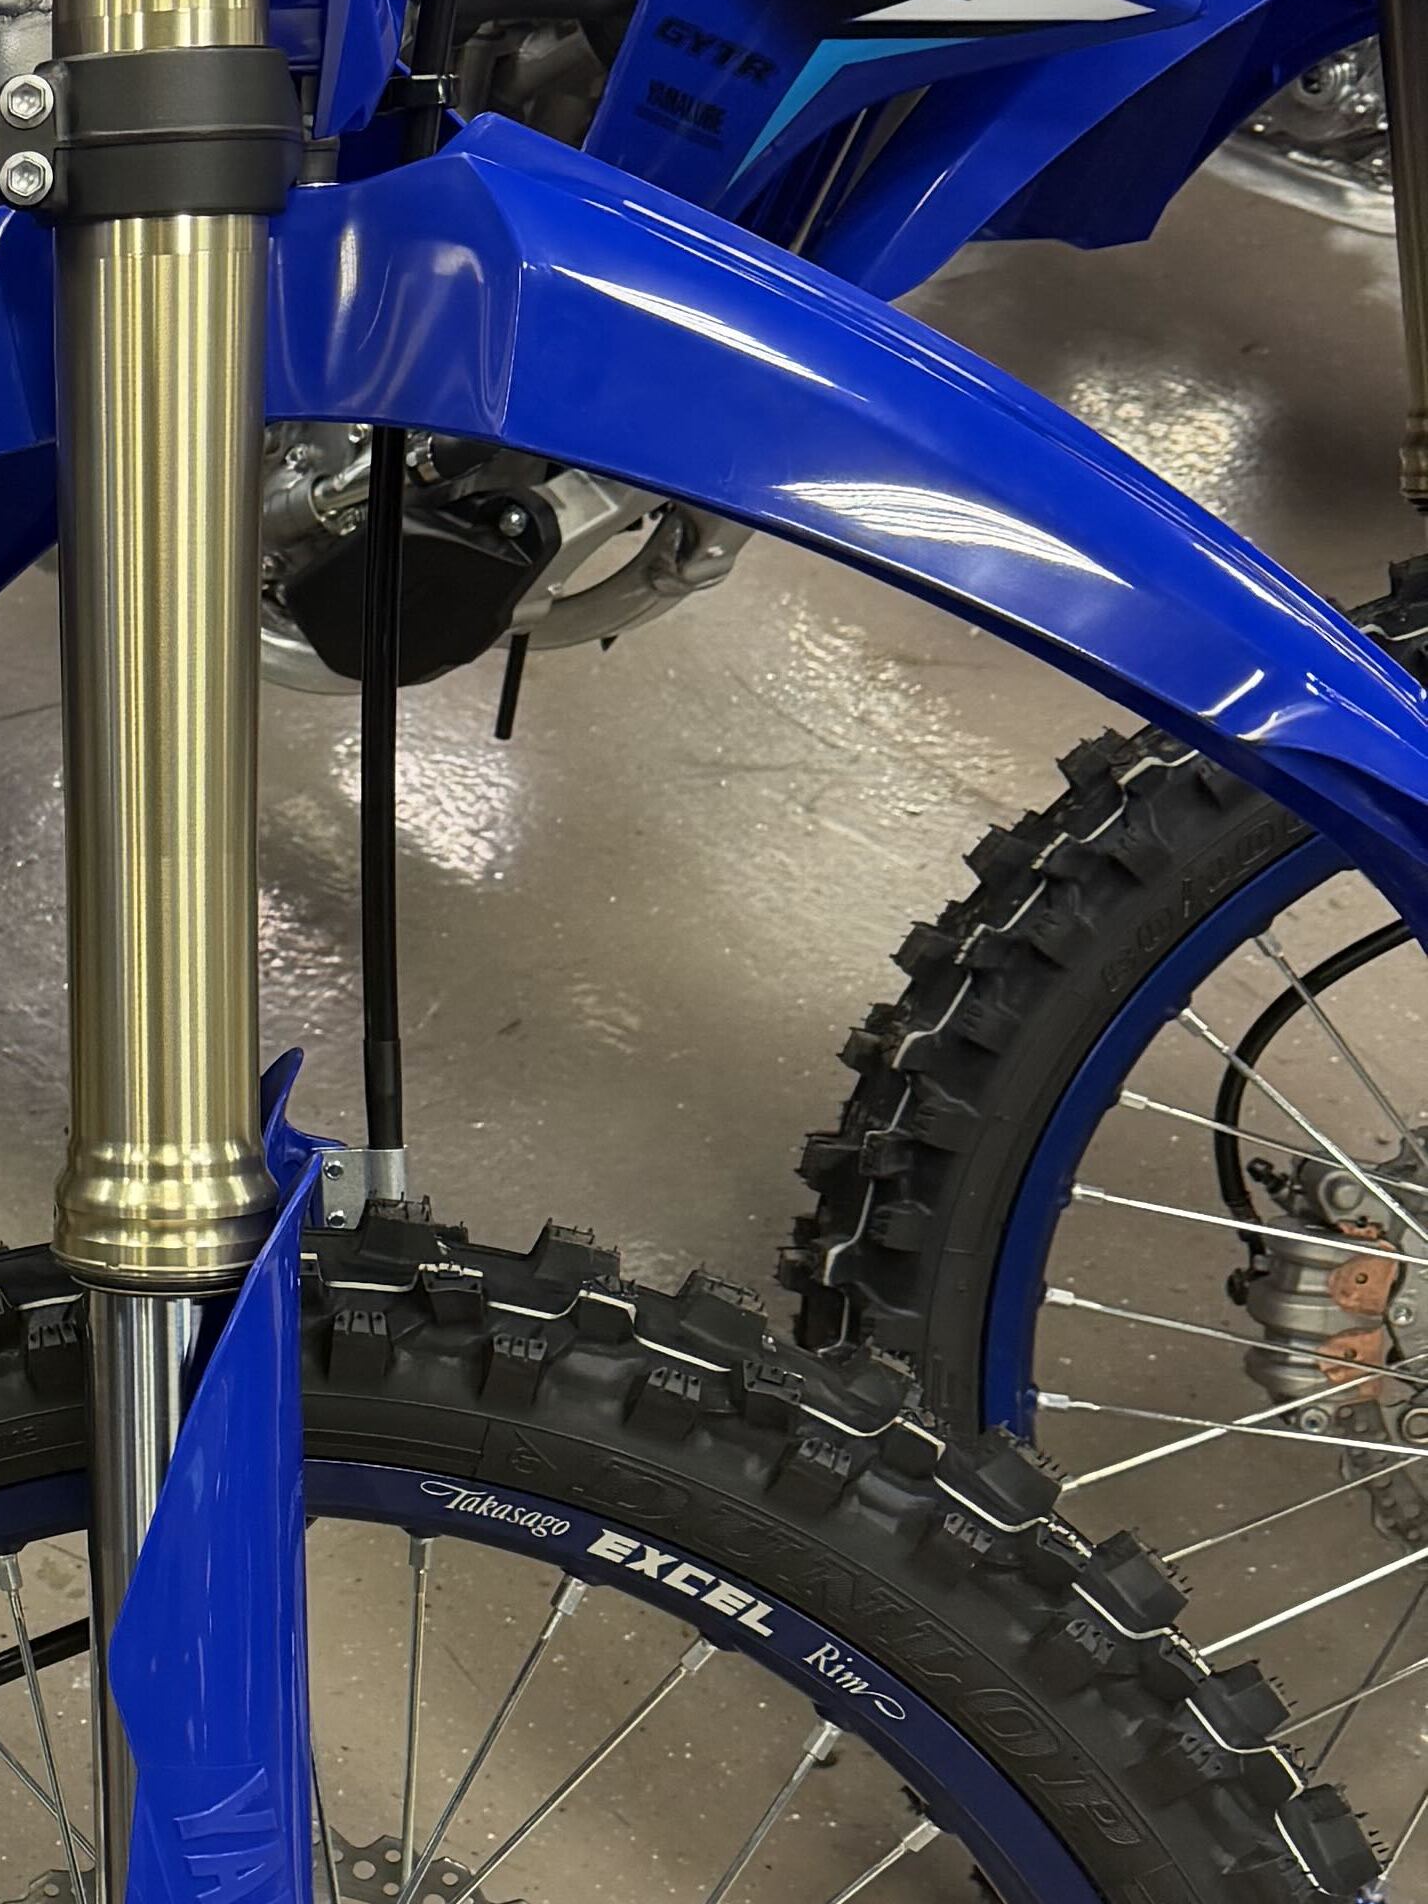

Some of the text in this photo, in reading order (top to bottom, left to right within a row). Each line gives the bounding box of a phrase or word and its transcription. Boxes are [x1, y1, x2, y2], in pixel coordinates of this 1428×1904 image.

[655, 15, 778, 85] GYTR
[420, 1480, 907, 1722] Takasago EXCEL Rim
